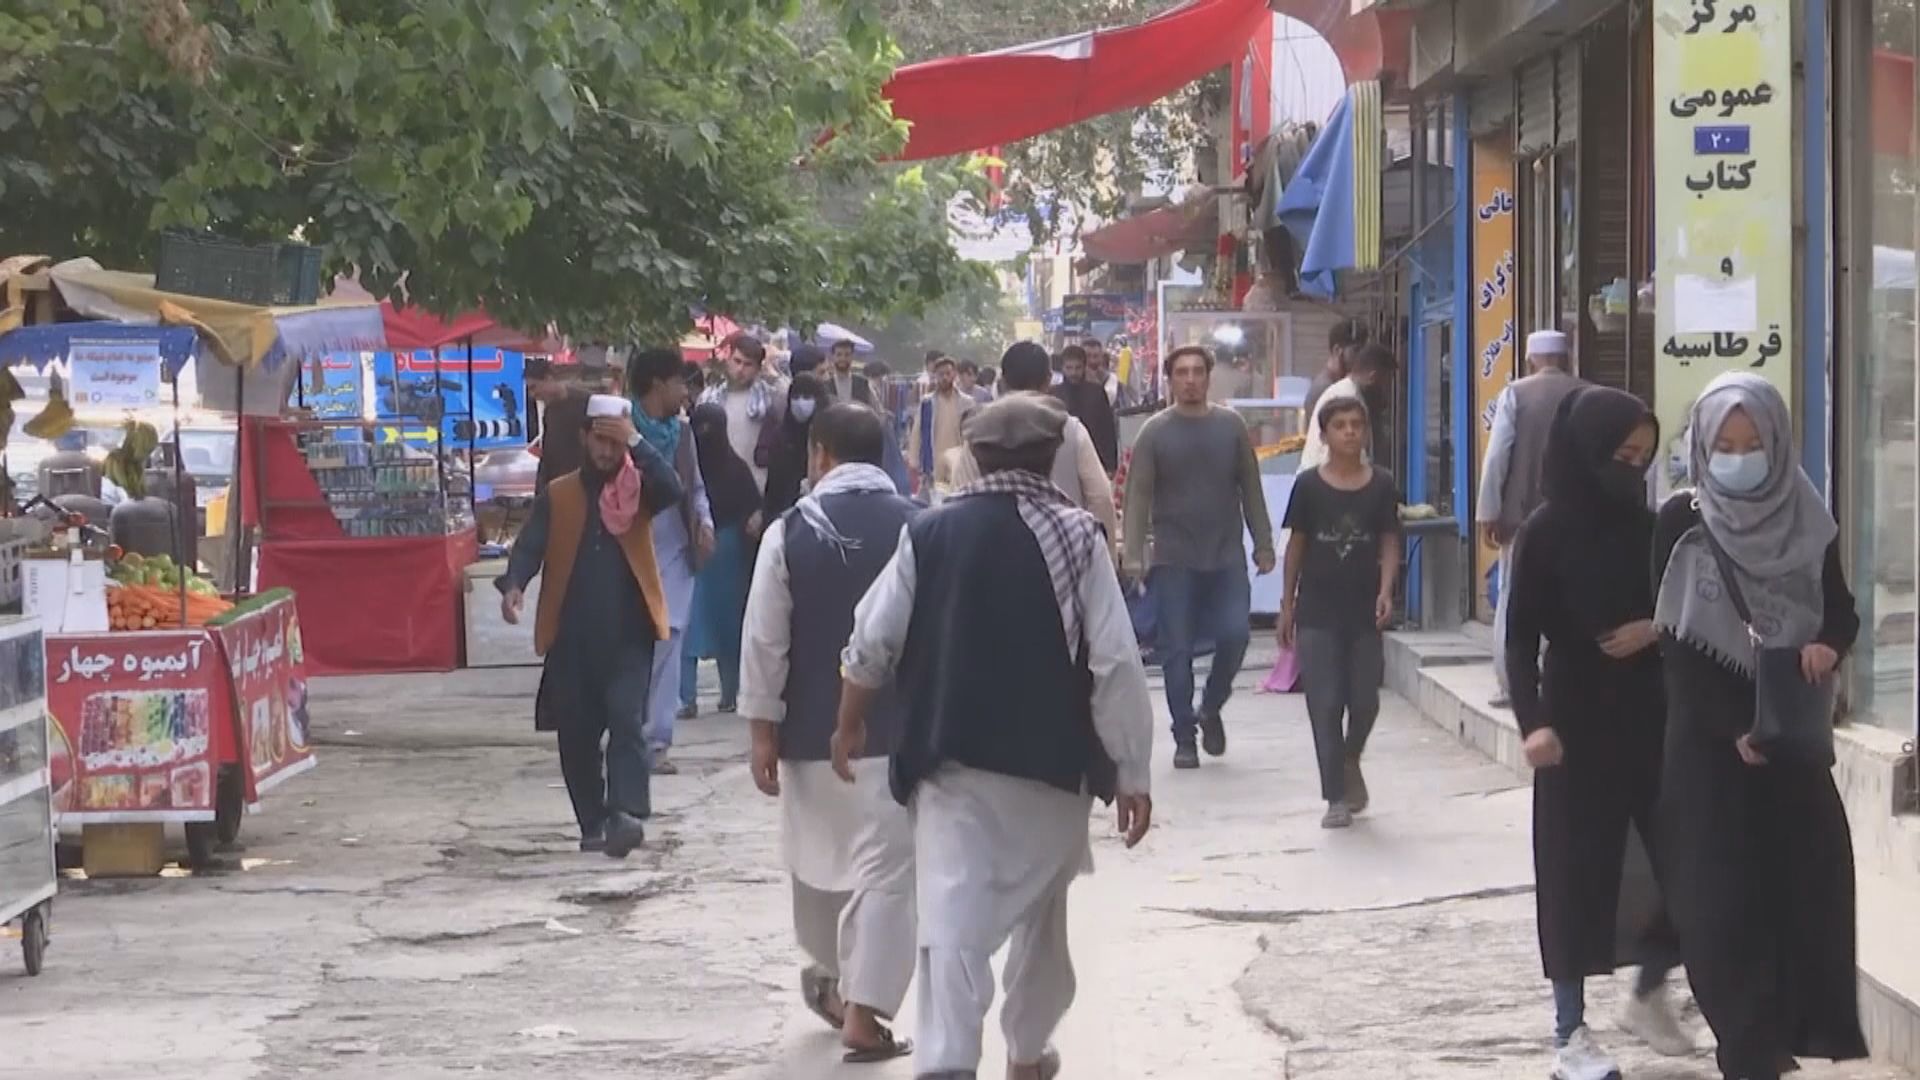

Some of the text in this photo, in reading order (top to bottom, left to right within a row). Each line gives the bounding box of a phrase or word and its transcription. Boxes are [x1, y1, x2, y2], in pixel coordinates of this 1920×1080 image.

[1684, 0, 1756, 34] مرکز
[1670, 80, 1773, 118] عمومی
[1710, 133, 1732, 149] ۲۰
[1685, 159, 1757, 199] کتاب
[1719, 256, 1734, 278] و
[1663, 322, 1782, 368] قرطاسیه
[56, 645, 115, 683] چهار
[122, 640, 205, 681] آبمیوه
